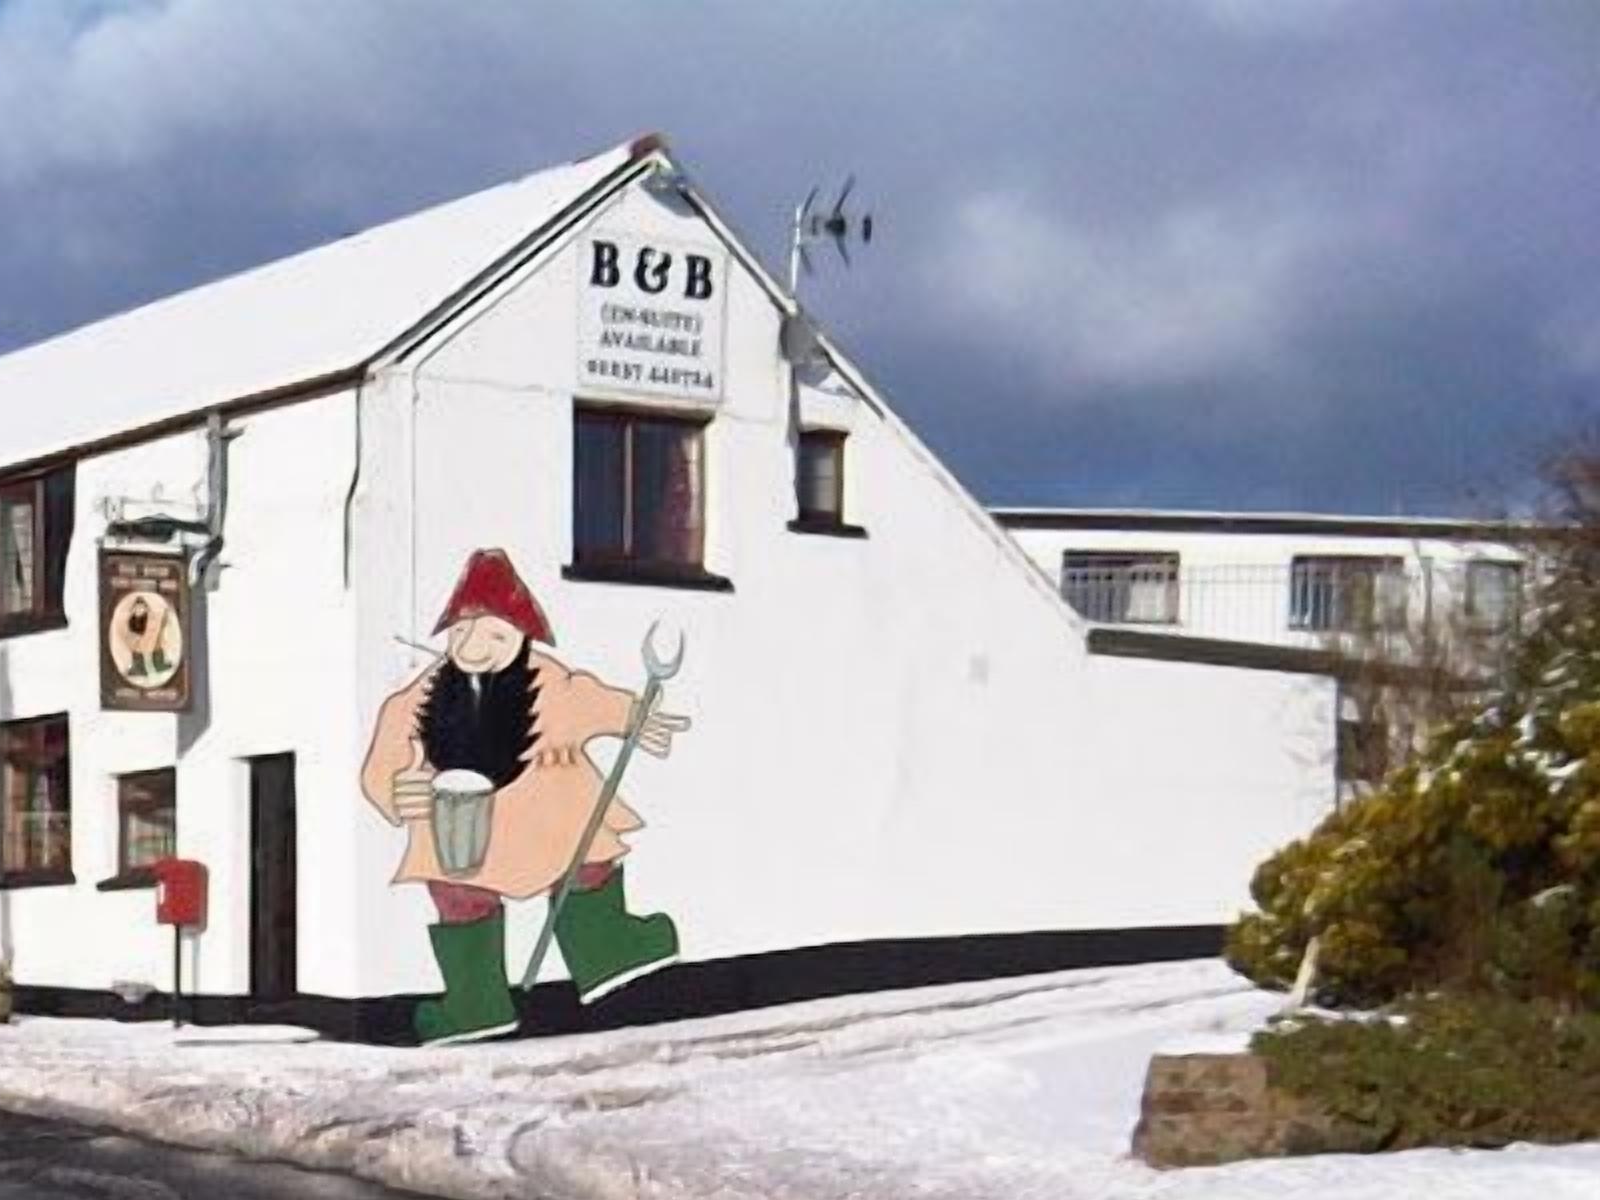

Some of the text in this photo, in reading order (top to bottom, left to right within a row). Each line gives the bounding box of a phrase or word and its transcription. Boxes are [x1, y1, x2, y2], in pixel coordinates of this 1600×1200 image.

[590, 240, 712, 300] B & B
[600, 331, 702, 358] AVAILABLE
